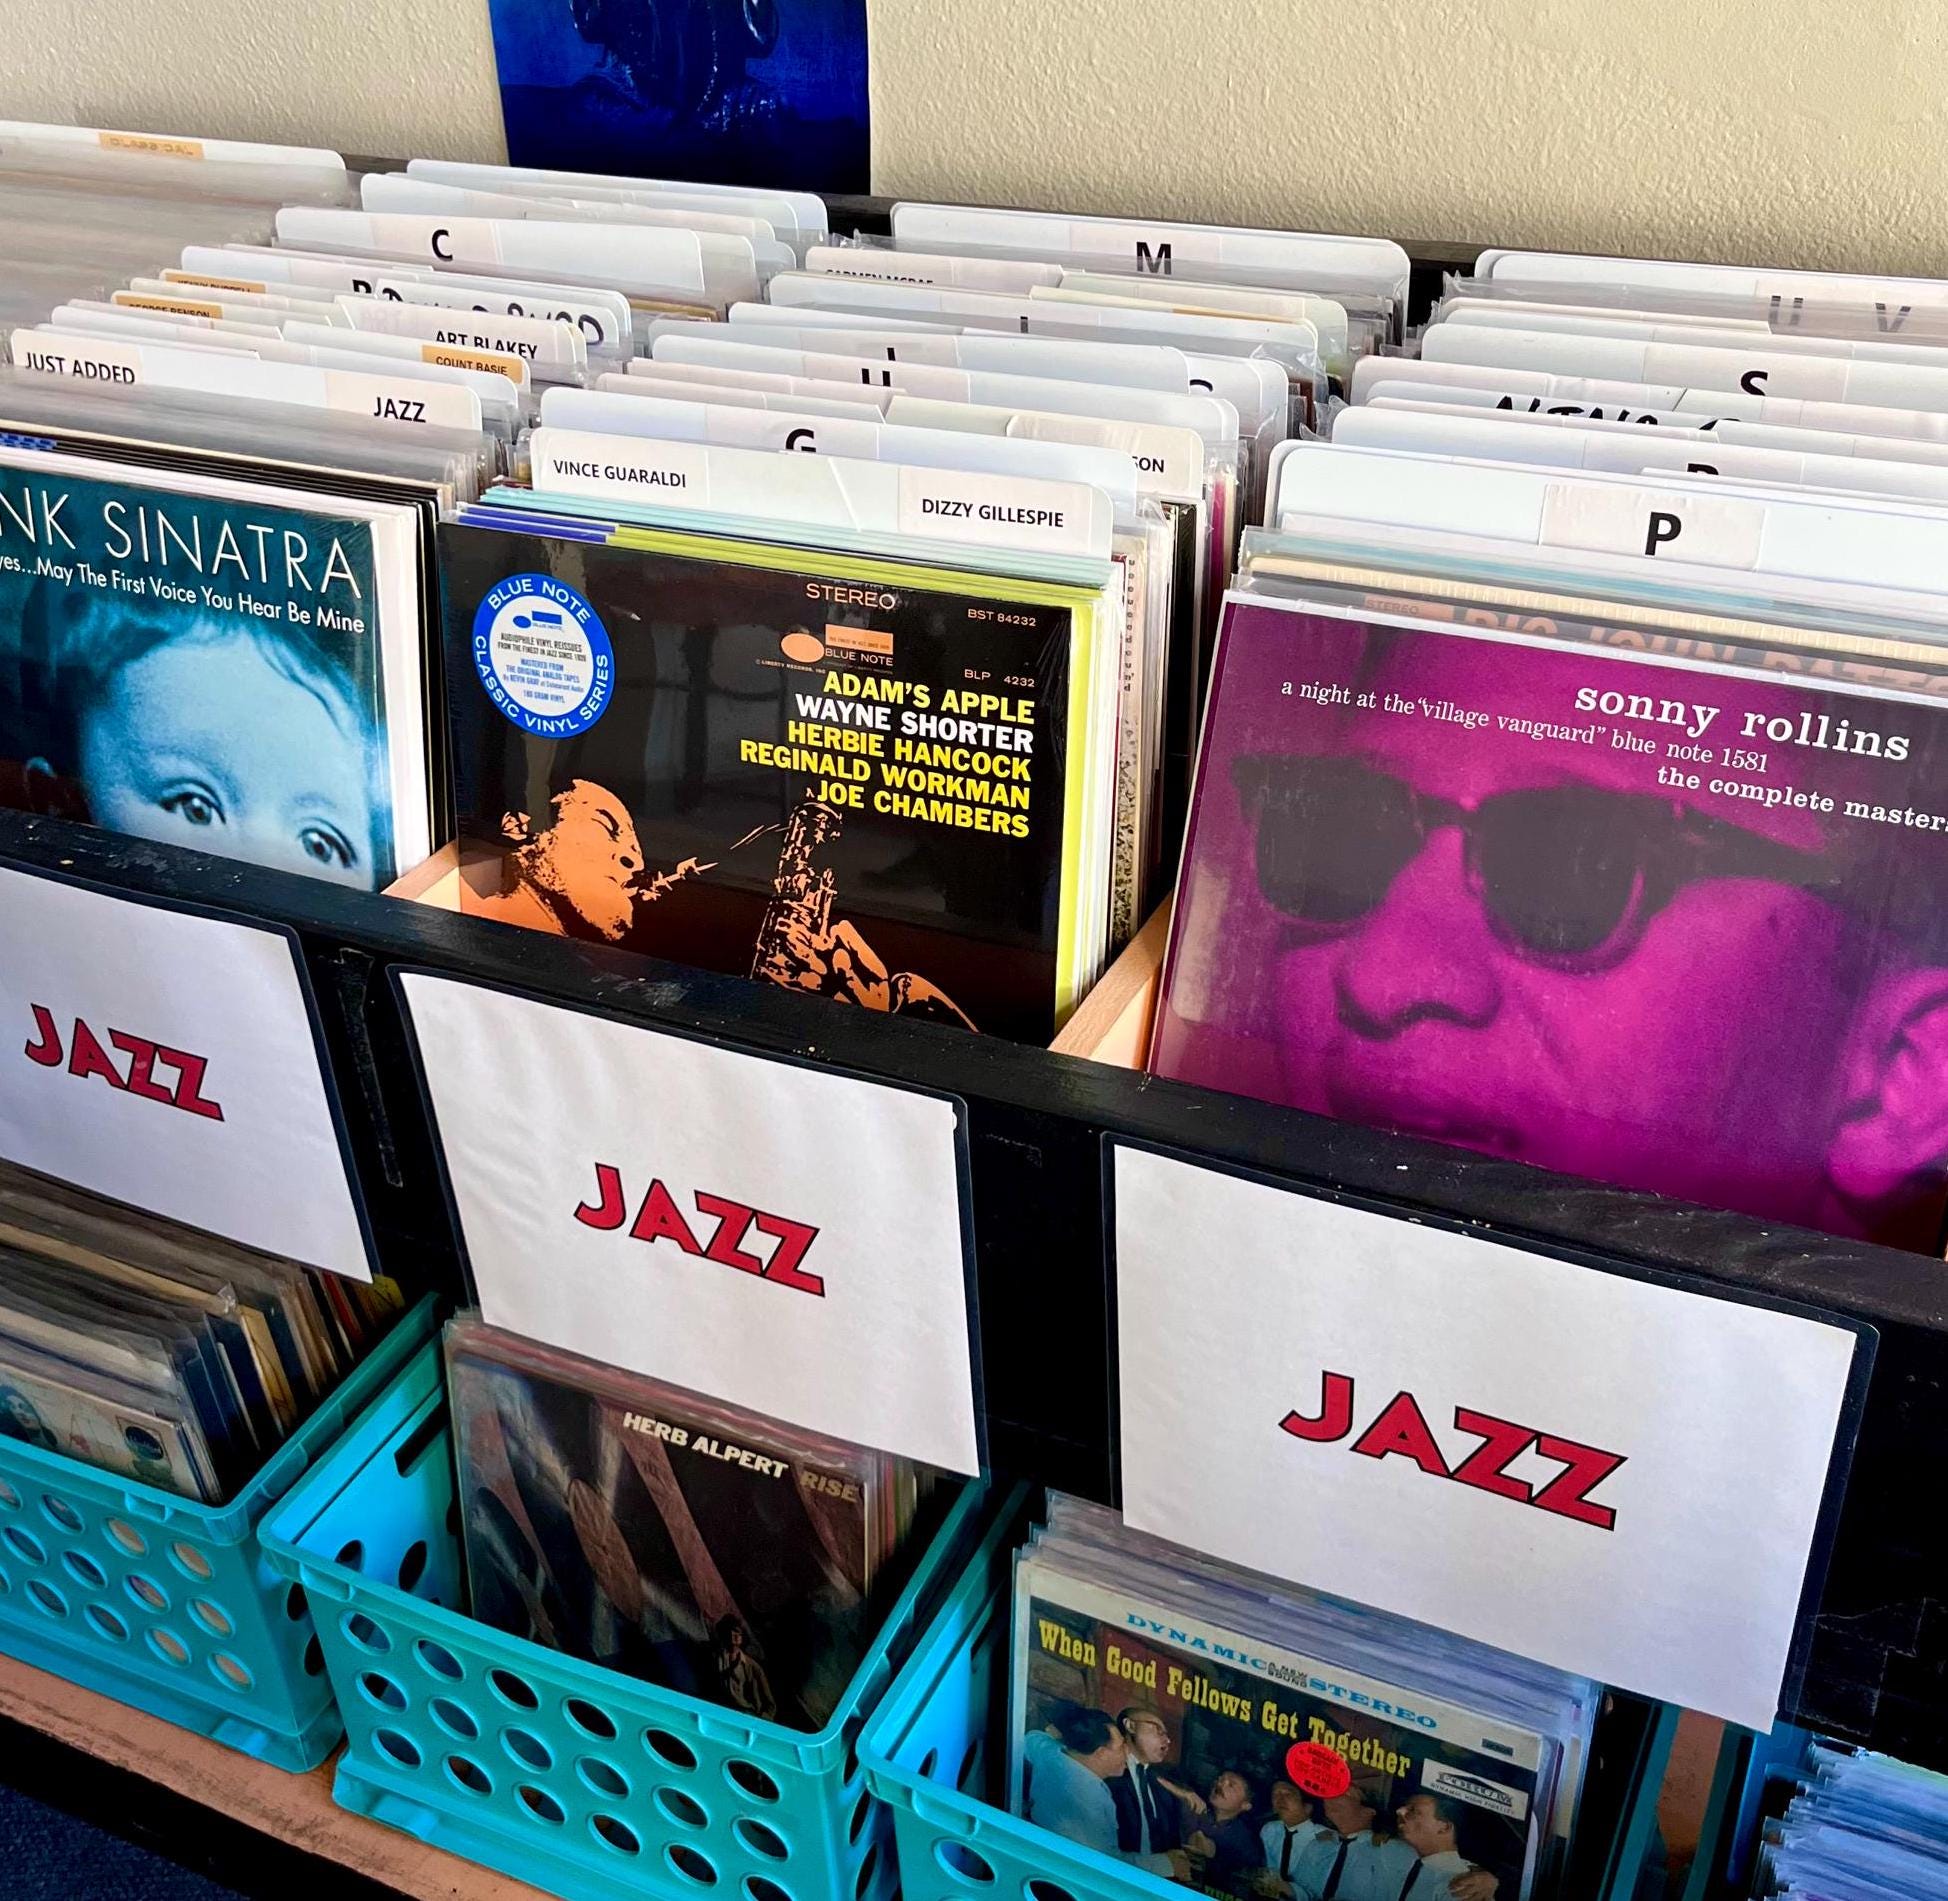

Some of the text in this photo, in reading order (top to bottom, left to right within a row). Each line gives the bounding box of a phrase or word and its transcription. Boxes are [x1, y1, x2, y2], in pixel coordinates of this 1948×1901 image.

[432, 229, 453, 262] C
[1136, 242, 1172, 275] M
[25, 352, 136, 384] JUST ADDED
[373, 396, 426, 424] JAZZ
[553, 460, 687, 488] VINCE GUARALDI
[922, 498, 1064, 528] DIZZY GILLESPIE
[1643, 511, 1682, 556] P
[104, 500, 362, 599] SINATRA
[76, 563, 108, 588] The
[112, 571, 146, 595] First
[150, 576, 197, 604] Voice
[200, 586, 233, 612] You
[238, 592, 282, 620] Hear
[287, 601, 311, 625] Be
[316, 607, 365, 634] Mine
[488, 578, 591, 624] BLUE NOTE
[806, 583, 896, 610] STEREO
[968, 608, 1036, 626] BST 84232
[475, 635, 609, 733] CLASSIC VINYL SERIES
[825, 647, 894, 666] BLUE NOTE
[964, 668, 1036, 688] BLP 4232
[795, 693, 1034, 754] WAYNE SHORTER
[823, 670, 1035, 725] ADAM’S APPLE
[1575, 686, 1912, 762] sonny rollins
[788, 720, 1032, 782] HERBIE HANCOCK
[1281, 680, 1292, 695] a
[1300, 680, 1351, 706] night
[1356, 689, 1377, 708] at
[1383, 692, 1415, 715] the
[1610, 728, 1656, 754] blue
[1665, 738, 1714, 765] note
[1721, 746, 1770, 774] 1581
[740, 739, 1030, 810] REGINALD WORKMAN
[1656, 764, 1948, 832] the complete master
[817, 780, 1030, 838] JOE CHAMBERS
[24, 1003, 225, 1122] JAZZ
[574, 1162, 826, 1297] JAZZ
[622, 1412, 861, 1502] HERB ALPERT RISE
[1278, 1370, 1630, 1532] JAZZ
[1126, 1612, 1267, 1671] DYNAMIC
[1038, 1619, 1097, 1668] When
[1106, 1645, 1157, 1689] Good
[1166, 1668, 1252, 1721] Fellows
[1262, 1700, 1300, 1740] Get
[1308, 1716, 1411, 1778] Together
[1309, 1678, 1438, 1729] STEREO
